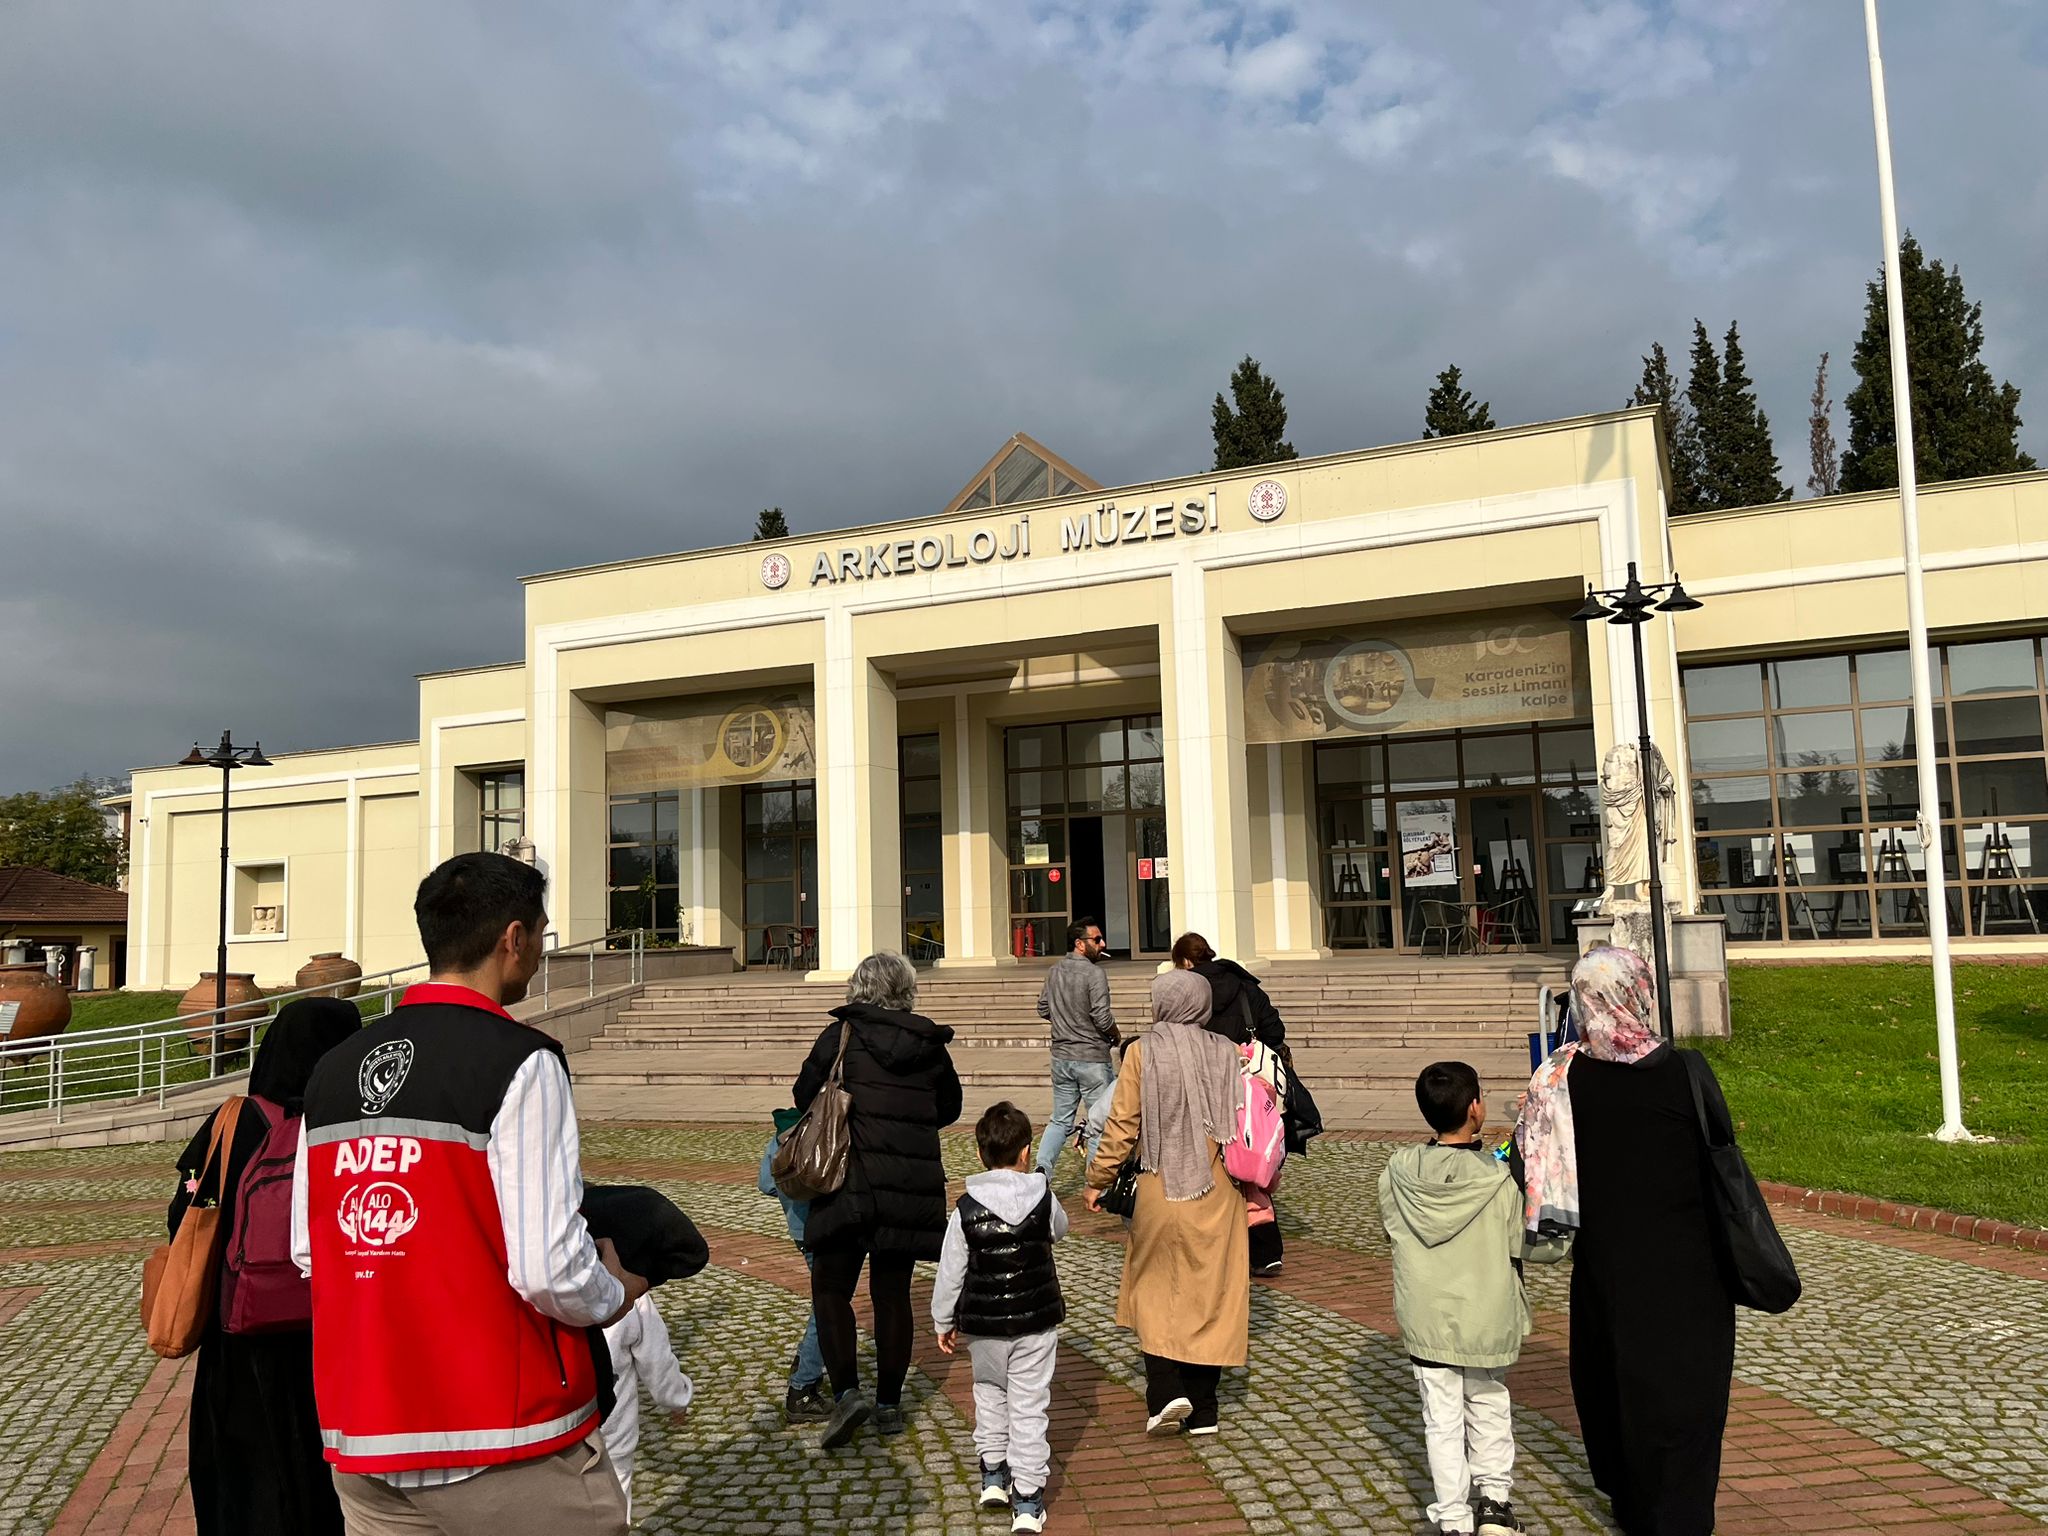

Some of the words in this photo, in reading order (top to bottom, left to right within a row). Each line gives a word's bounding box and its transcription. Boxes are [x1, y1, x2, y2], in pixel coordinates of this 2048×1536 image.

[809, 513, 1031, 585] ARKEOLOJİ
[1060, 487, 1218, 552] MÜZESİ
[1465, 661, 1567, 683] Karadeniz'in
[1462, 682, 1510, 698] Sessiz
[1513, 678, 1567, 693] Limanı
[1521, 693, 1568, 707] Kalpe
[334, 1136, 422, 1177] ADEP
[368, 1193, 391, 1209] ALO
[362, 1209, 405, 1232] 144
